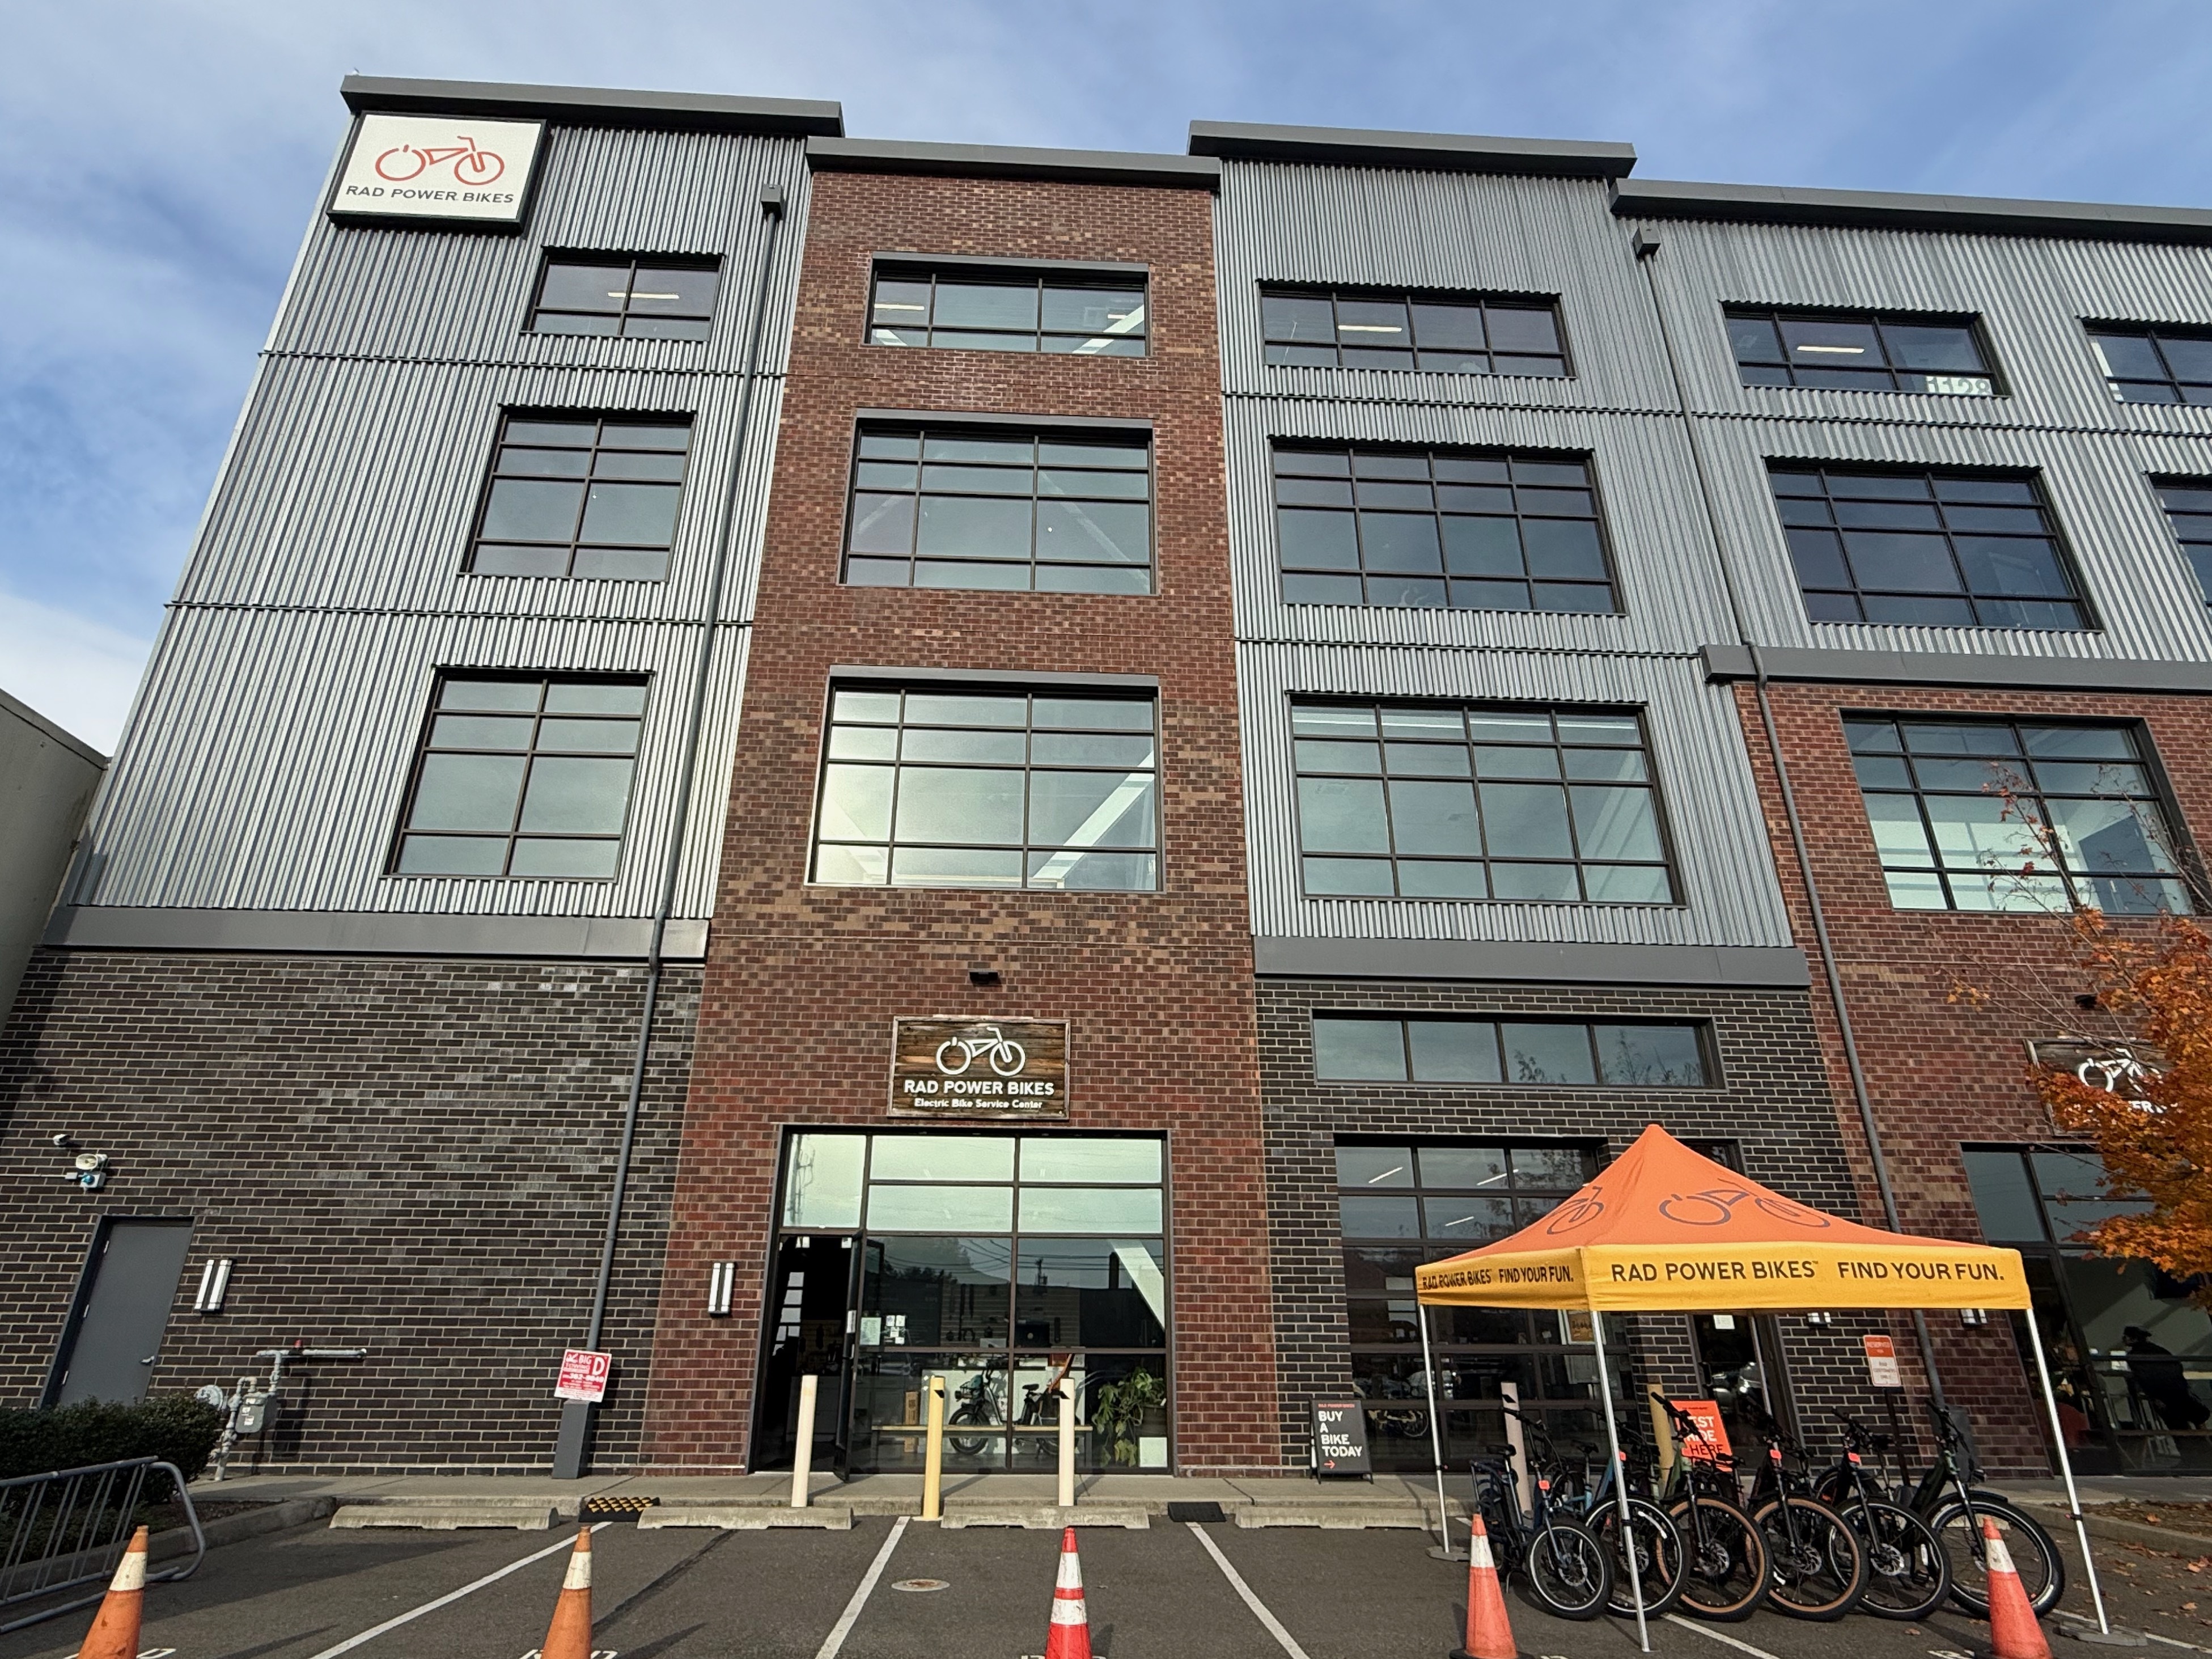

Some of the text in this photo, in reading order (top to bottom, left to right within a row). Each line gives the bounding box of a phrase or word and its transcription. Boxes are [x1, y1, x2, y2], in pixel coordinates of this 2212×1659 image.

[346, 185, 514, 203] RAD POWER BIKES
[904, 1080, 1054, 1095] RAD POWER BIKES
[914, 1098, 1043, 1108] Electric Bike Service Center
[1422, 1266, 1574, 1290] RAD POWER BIKES FIND YOUR FUN.
[1611, 1264, 1657, 1282] RAD
[1665, 1262, 1747, 1281] POWER
[1837, 1262, 1888, 1279] FIND
[1890, 1263, 1952, 1280] YOUR
[1954, 1263, 2005, 1280] FUN.
[579, 1355, 592, 1365] BIG
[592, 1357, 605, 1376] D
[1318, 1411, 1343, 1422] BUY
[1320, 1422, 1329, 1433] A
[1321, 1434, 1350, 1445] BIKE
[1321, 1446, 1363, 1457] TODAY
